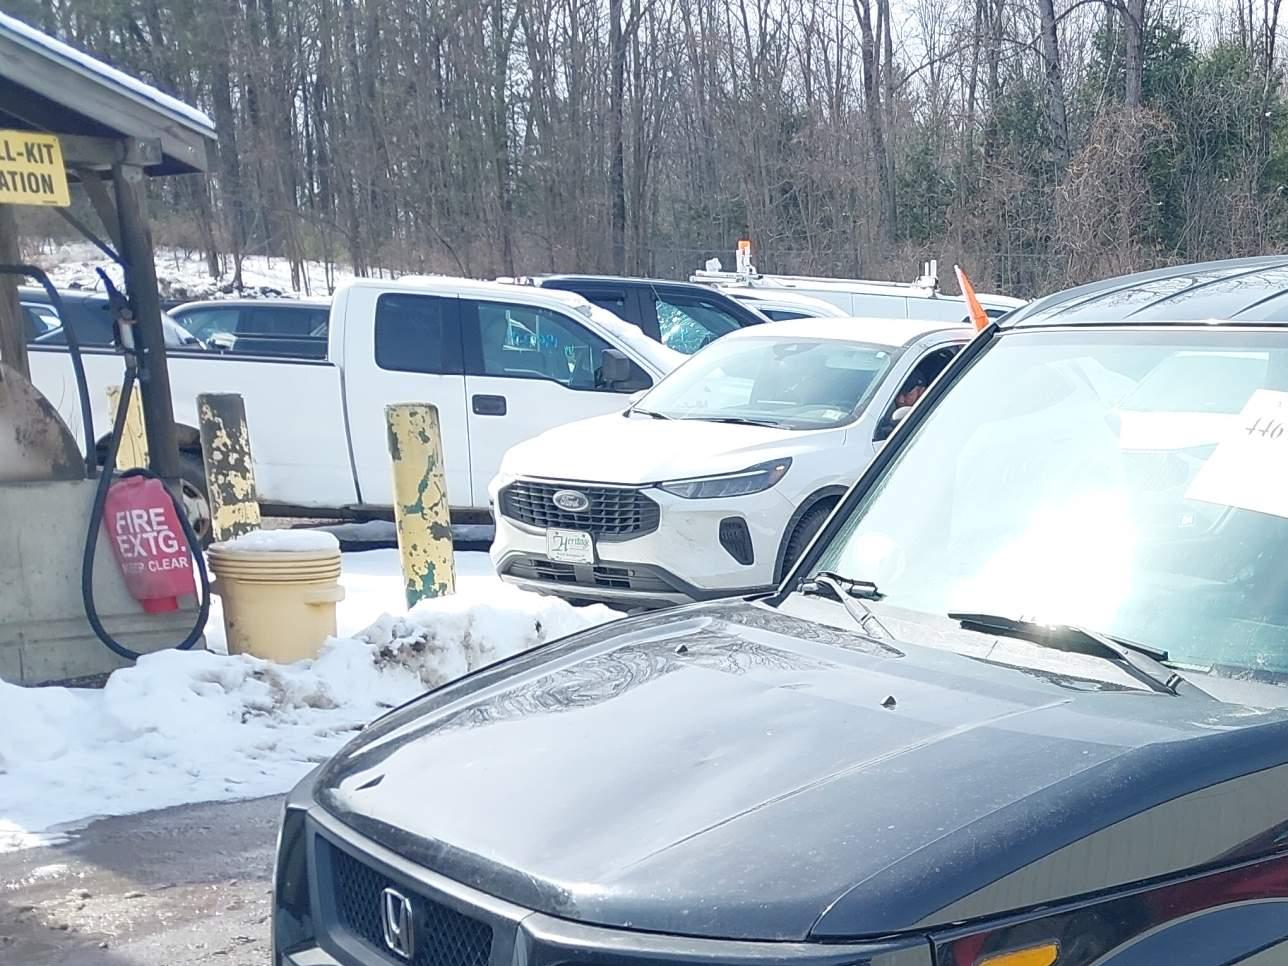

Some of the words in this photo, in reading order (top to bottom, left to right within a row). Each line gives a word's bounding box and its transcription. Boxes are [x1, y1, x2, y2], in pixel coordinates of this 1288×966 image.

[115, 507, 168, 534] FIRE
[115, 530, 186, 557] EXTG.
[148, 556, 189, 573] CLEAR
